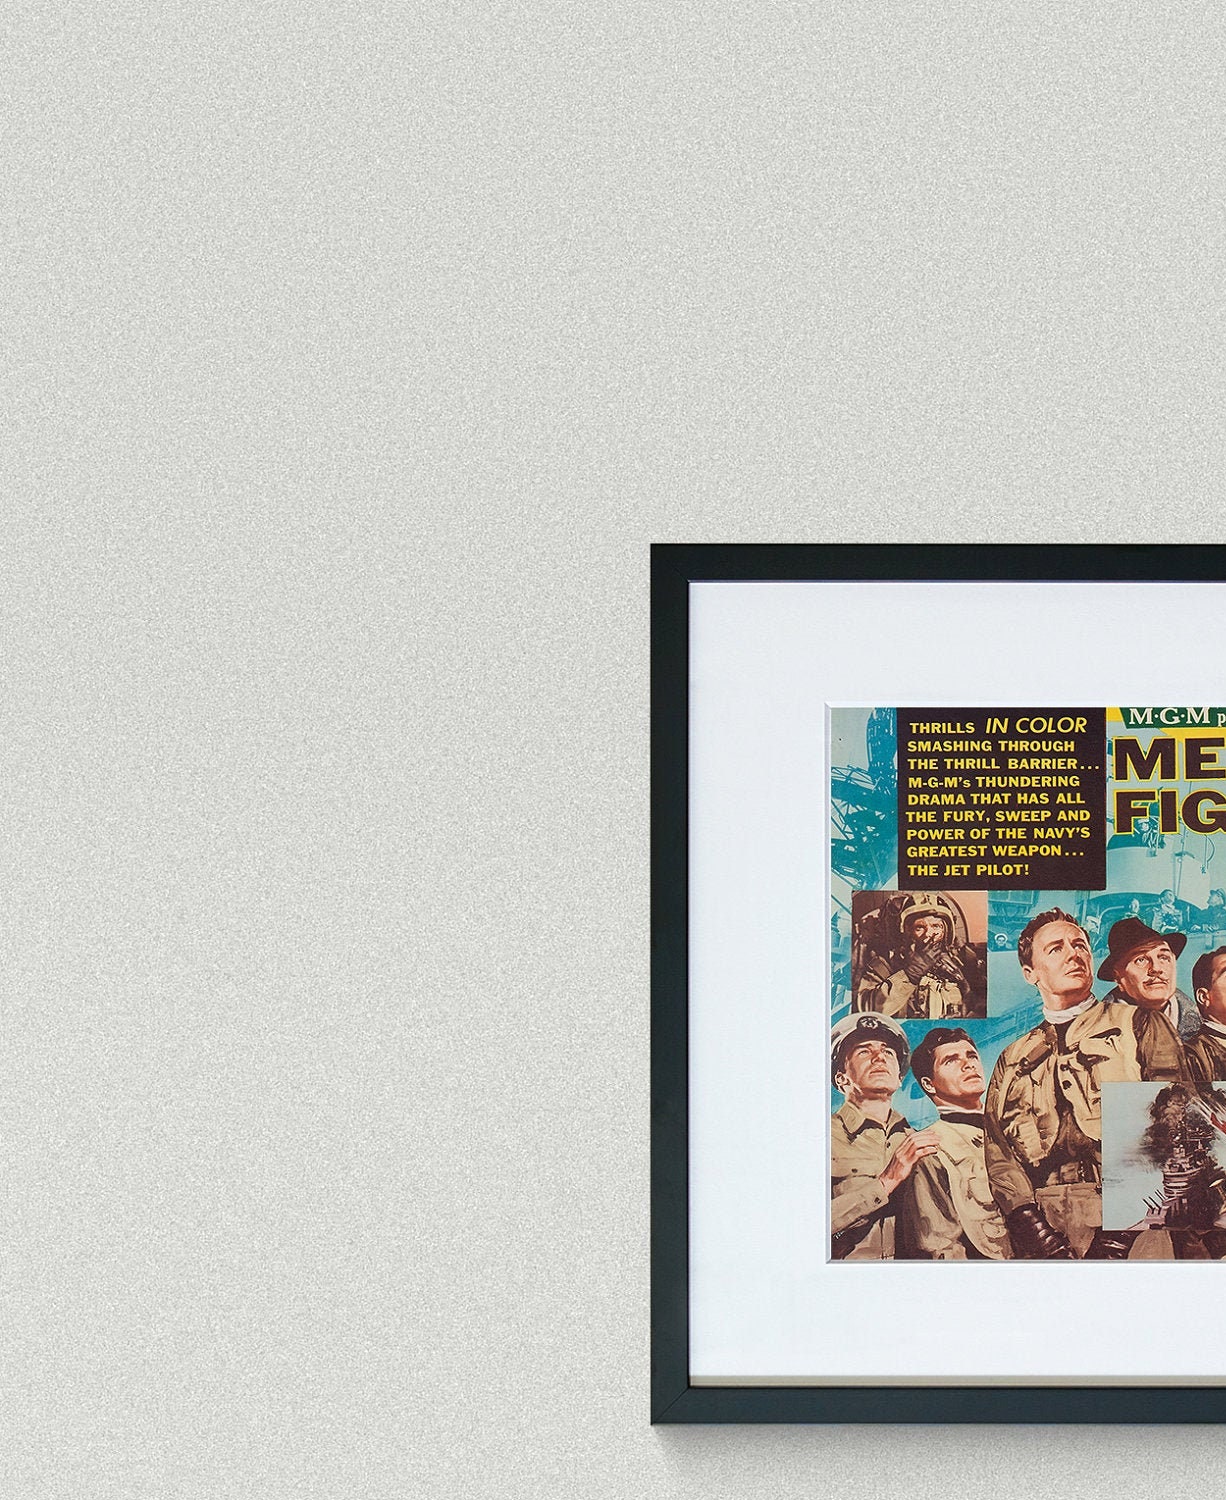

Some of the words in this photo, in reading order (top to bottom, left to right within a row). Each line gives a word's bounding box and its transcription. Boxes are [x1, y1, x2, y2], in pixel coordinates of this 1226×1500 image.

[910, 722, 975, 734] THRILLS
[985, 718, 1008, 734] IN
[1015, 717, 1088, 734] COLOR
[907, 741, 992, 752] SMASHING
[998, 740, 1075, 752] THROUGH
[907, 758, 938, 770] THE
[944, 758, 1000, 770] THRILL
[976, 776, 1080, 787] THUNDERING
[908, 794, 966, 806] DRAMA
[971, 794, 1012, 805] THAT
[1017, 793, 1050, 805] HAS
[1056, 793, 1085, 804] ALL
[906, 811, 937, 823] THE
[943, 811, 990, 823] FURY,
[995, 810, 1051, 822] SWEEP
[1057, 810, 1091, 821] AND
[907, 829, 965, 840] POWER
[970, 828, 991, 840] OF
[995, 828, 1027, 839] THE
[1033, 827, 1090, 839] NAVY'S
[907, 846, 987, 858] GREATEST
[907, 865, 938, 876] THE
[943, 864, 970, 876] JET
[976, 864, 1029, 876] PILOT!
